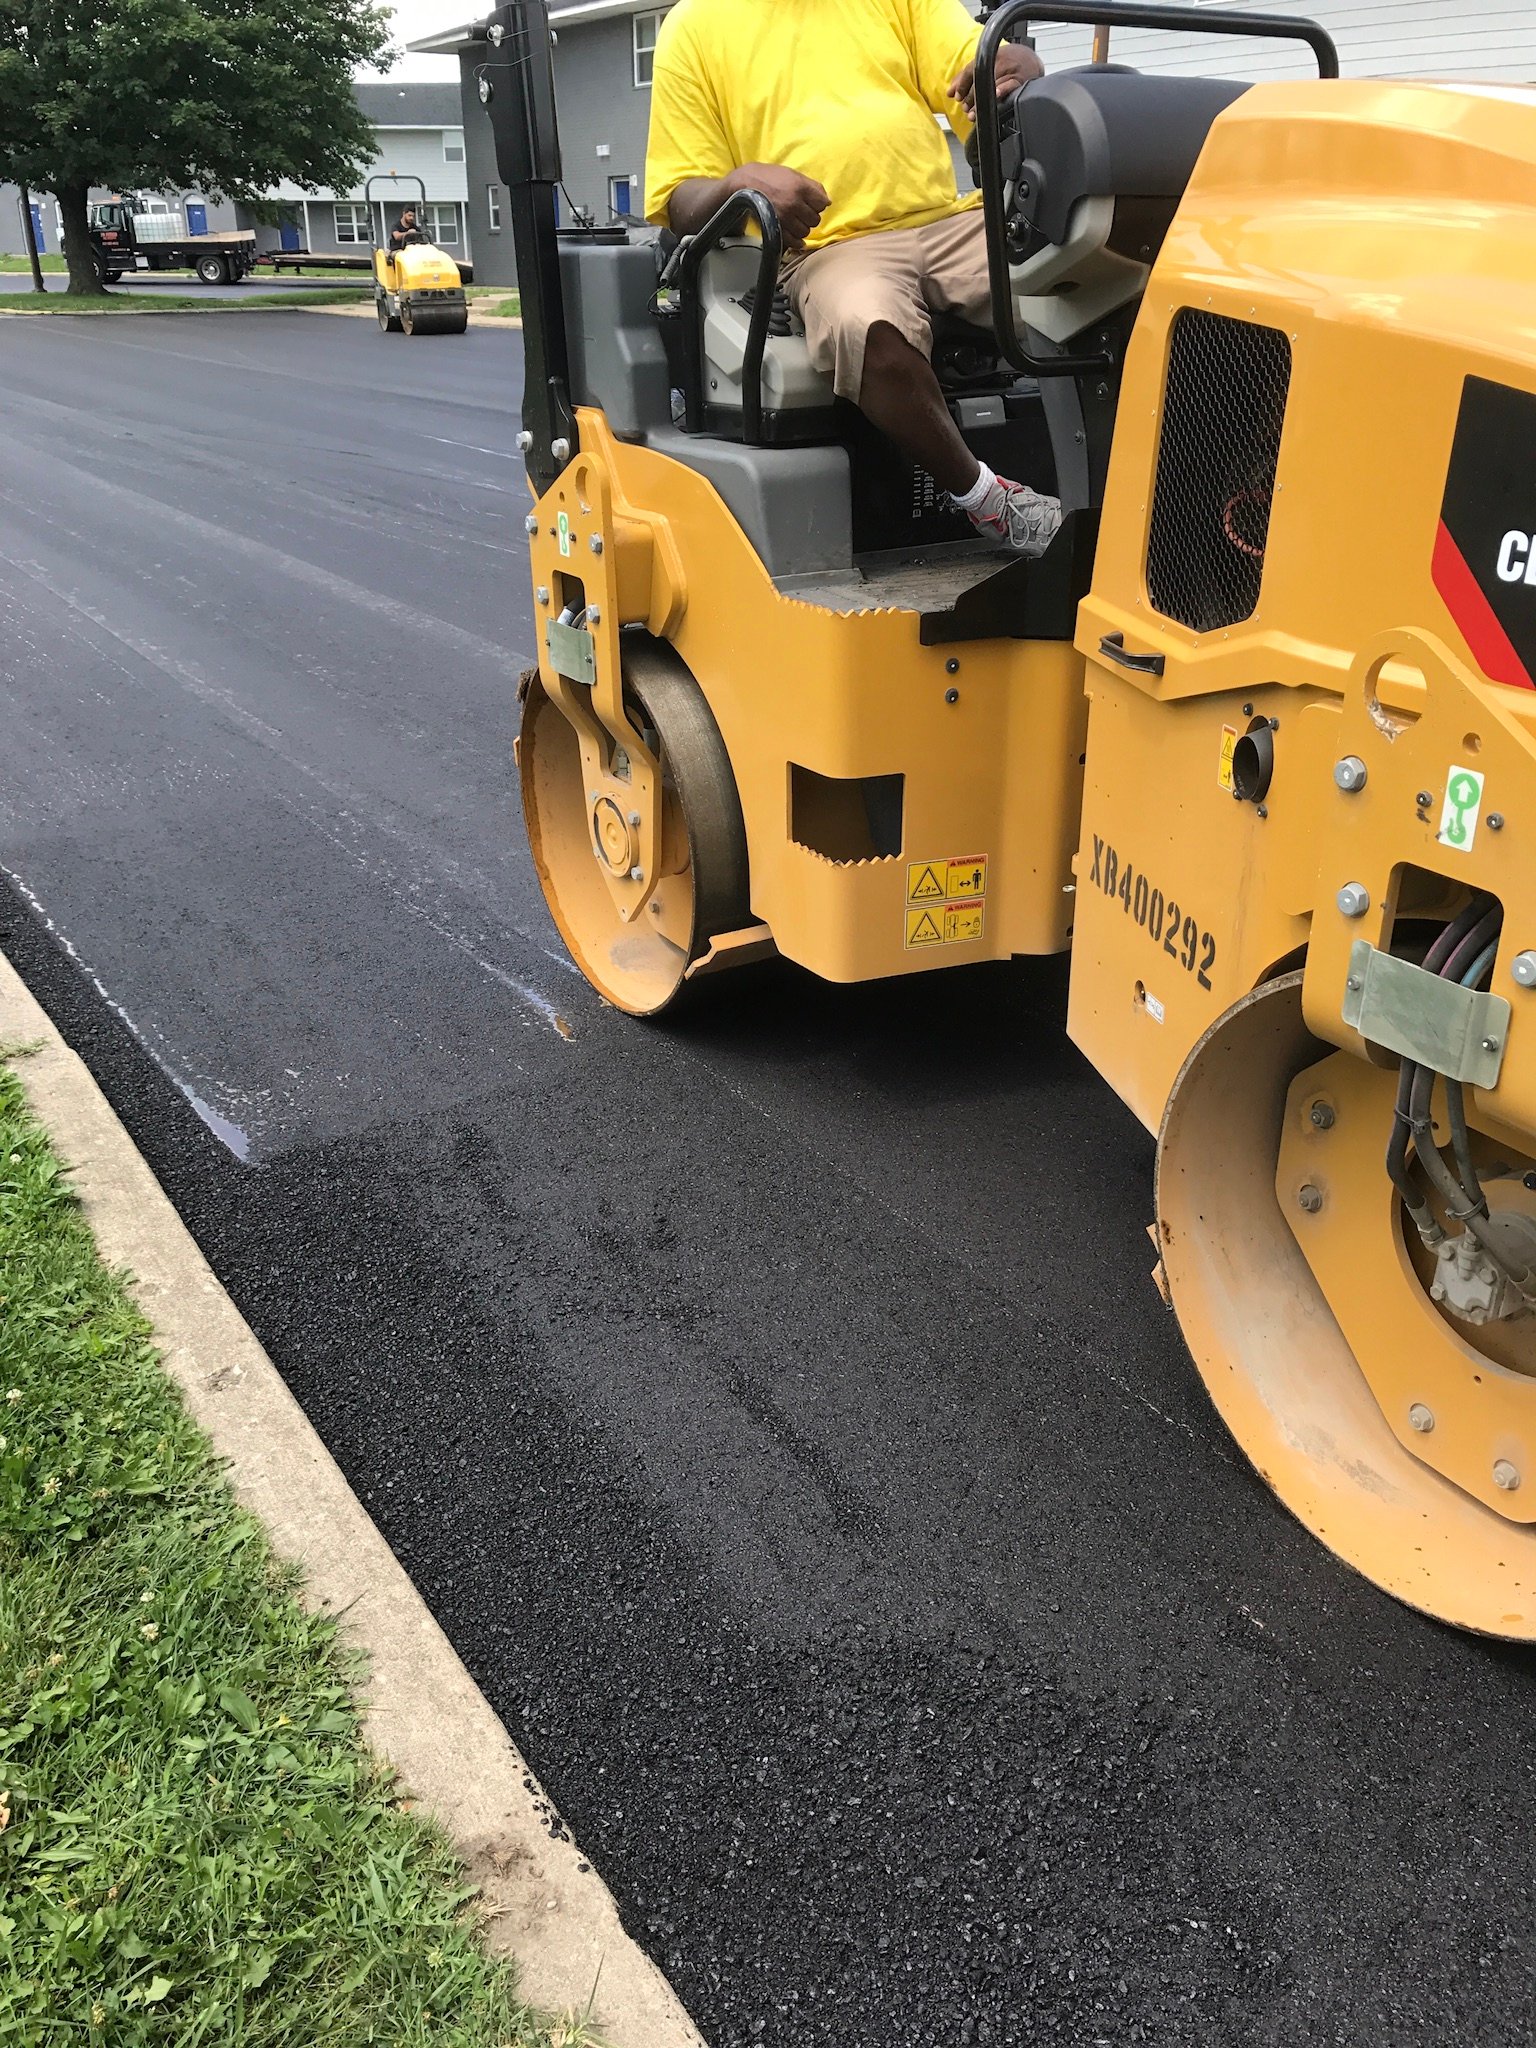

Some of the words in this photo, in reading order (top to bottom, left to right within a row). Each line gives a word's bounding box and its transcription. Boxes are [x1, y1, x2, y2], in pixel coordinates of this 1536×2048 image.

[957, 858, 984, 866] WARNING
[955, 902, 981, 910] WARNING
[1090, 833, 1216, 992] XB400292
